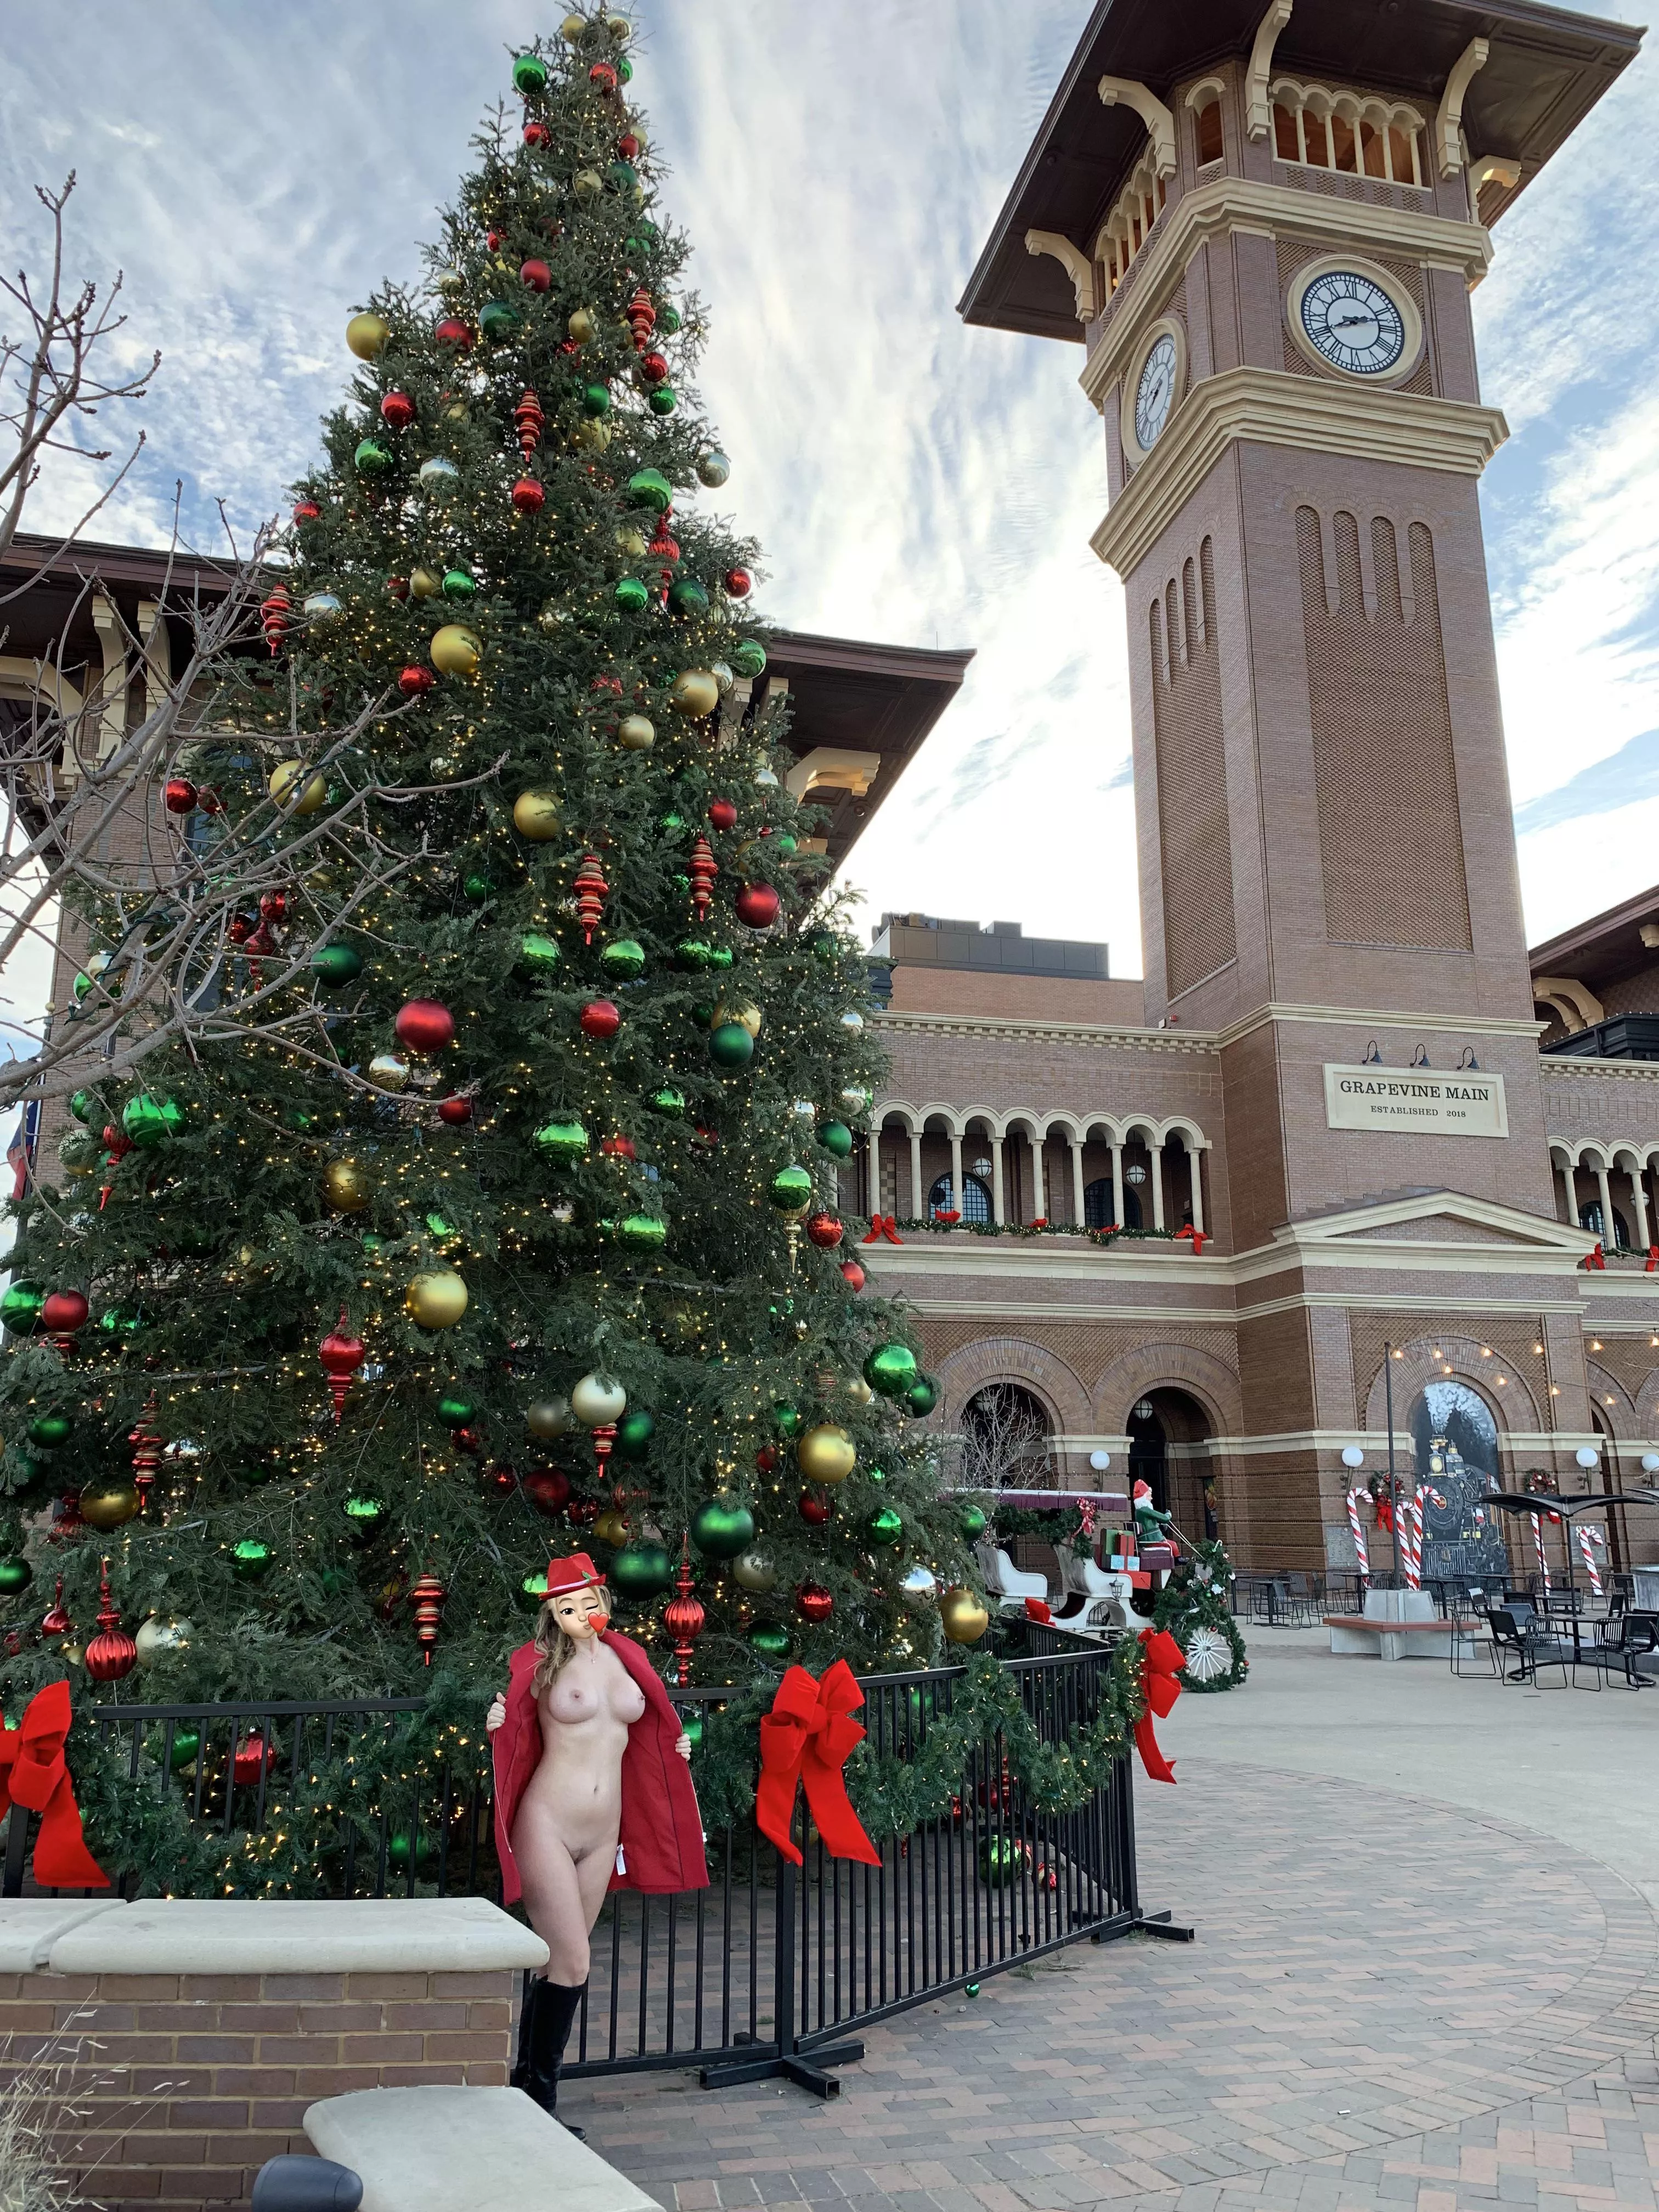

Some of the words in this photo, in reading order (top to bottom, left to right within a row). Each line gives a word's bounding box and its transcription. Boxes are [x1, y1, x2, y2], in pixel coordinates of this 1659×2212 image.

[1324, 283, 1340, 301] XI
[1344, 280, 1358, 298] XII
[1364, 290, 1373, 303] I
[1313, 293, 1330, 309] X
[1309, 311, 1327, 323] IX
[1374, 307, 1390, 317] II
[1379, 325, 1397, 334] III
[1328, 339, 1344, 360] VII
[1375, 336, 1396, 355] IIII
[1350, 348, 1362, 366] VI
[1368, 348, 1381, 365] V
[1340, 1080, 1441, 1098] GRAPEVINE
[1445, 1087, 1489, 1101] MAIN
[1370, 1105, 1438, 1116] ESTABLISHED
